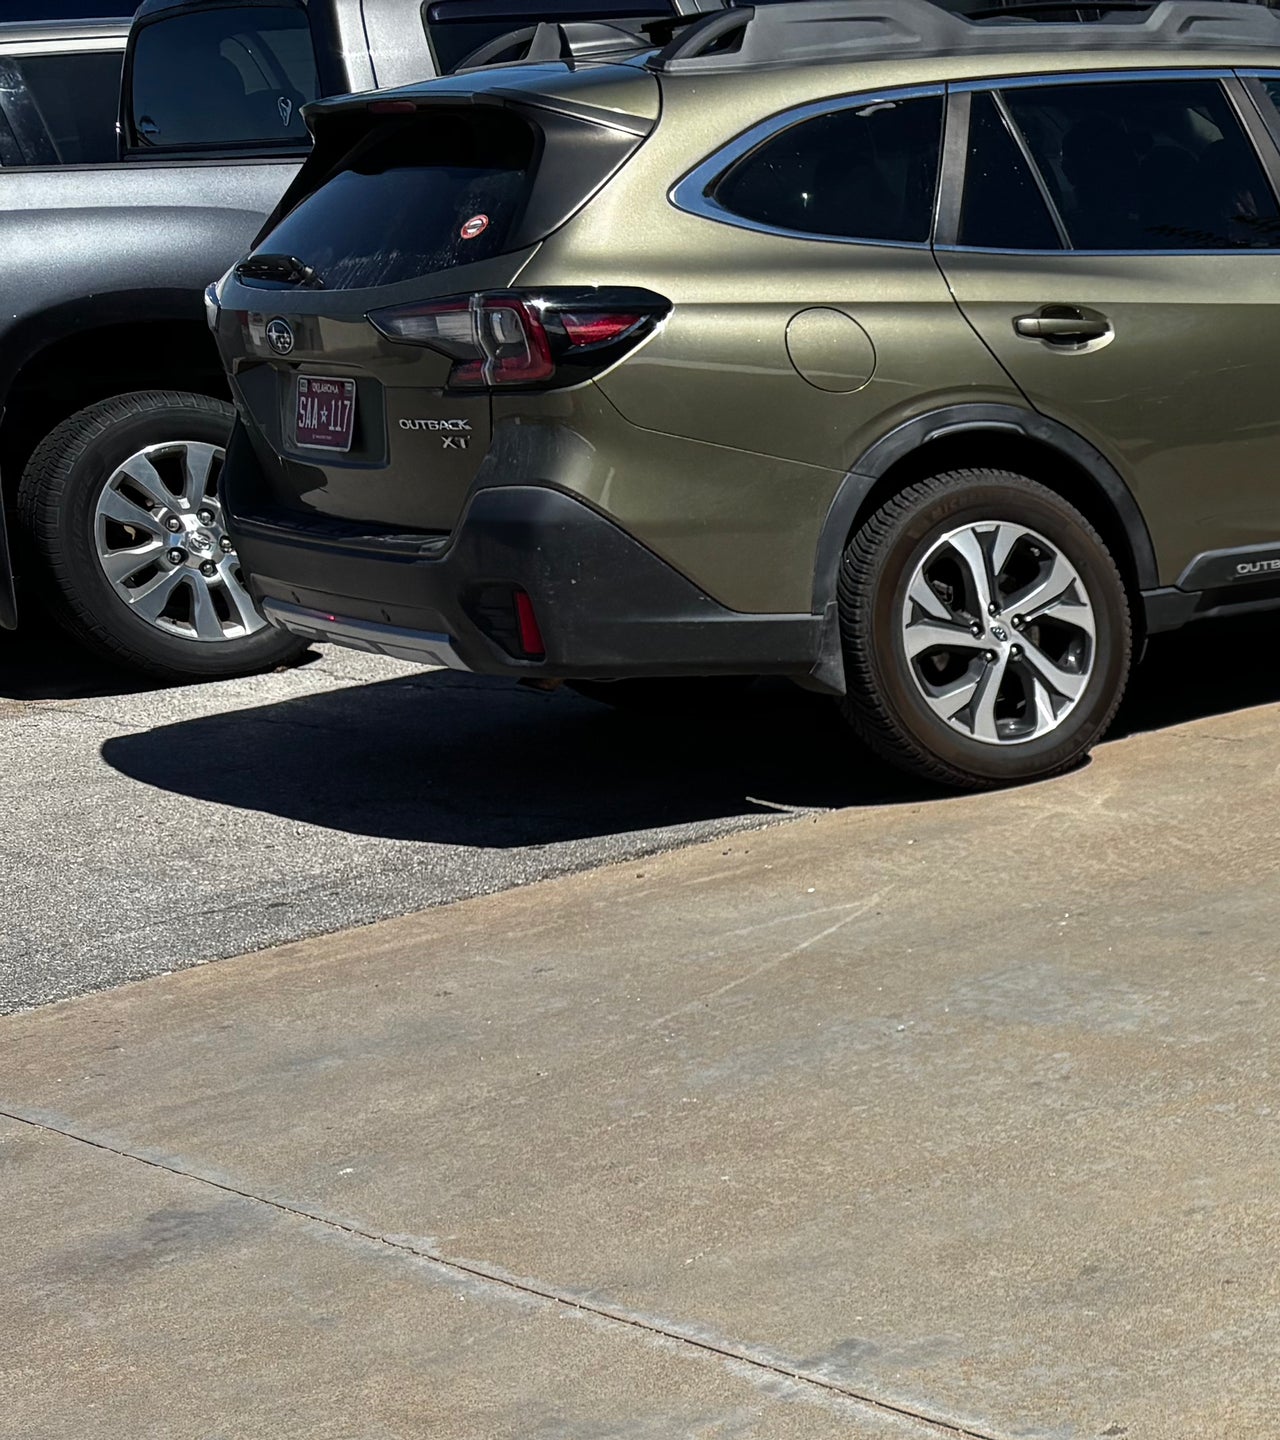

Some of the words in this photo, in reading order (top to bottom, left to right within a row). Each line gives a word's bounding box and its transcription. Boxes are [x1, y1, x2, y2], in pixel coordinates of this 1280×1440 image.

[312, 382, 339, 394] OKLAHOMA
[298, 396, 318, 429] SAA
[328, 399, 351, 432] 117
[399, 419, 472, 430] OUTBACK
[441, 435, 471, 449] XT
